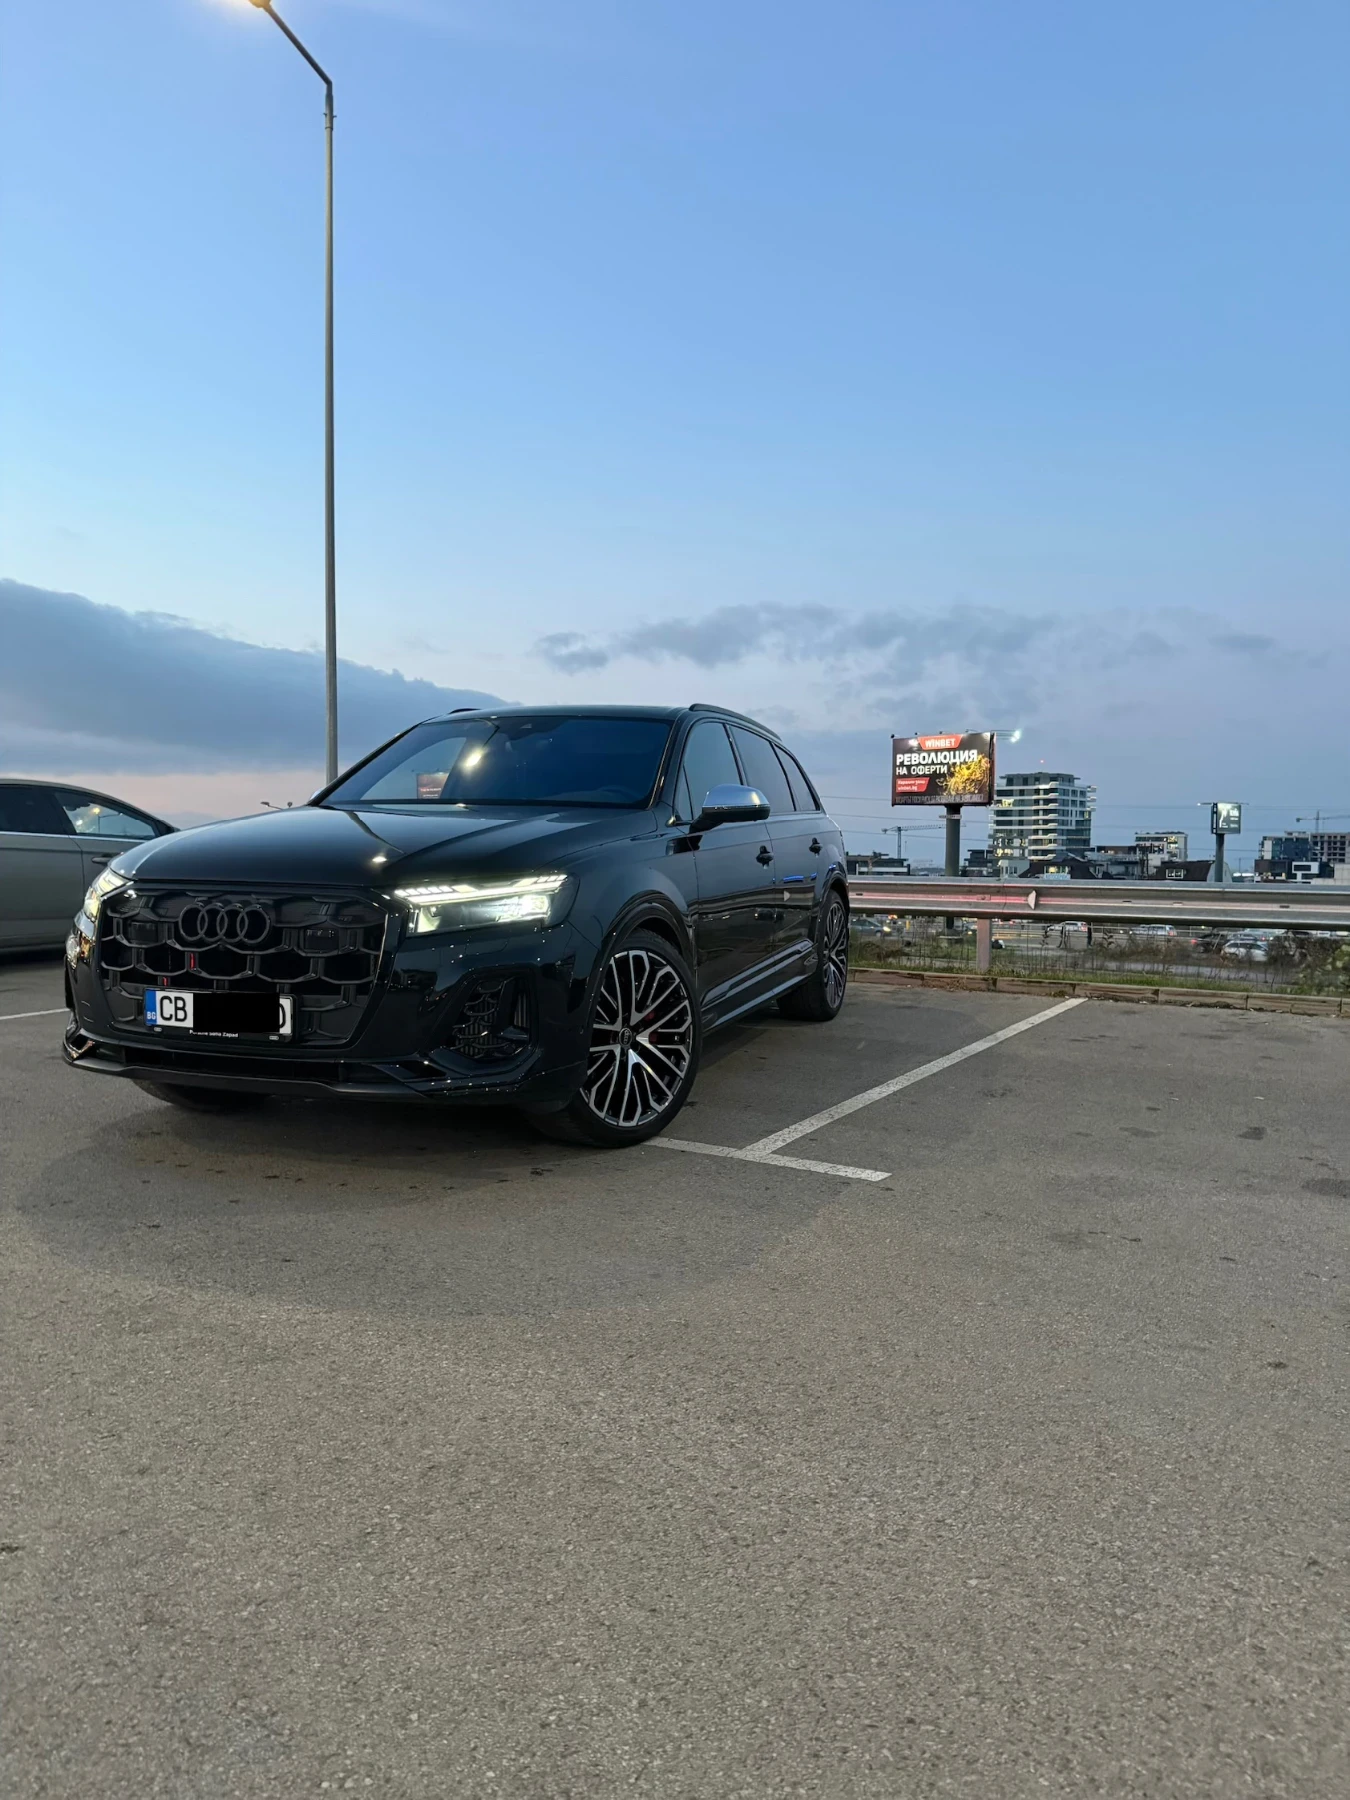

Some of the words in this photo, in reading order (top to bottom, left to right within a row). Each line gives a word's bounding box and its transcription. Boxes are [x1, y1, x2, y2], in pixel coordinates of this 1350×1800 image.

[925, 738, 955, 748] WINBET
[896, 749, 978, 766] РЕВОЛЮЦИЯ
[896, 767, 908, 776] НА
[911, 765, 948, 775] ОФЕРТИ
[146, 1011, 157, 1020] BG
